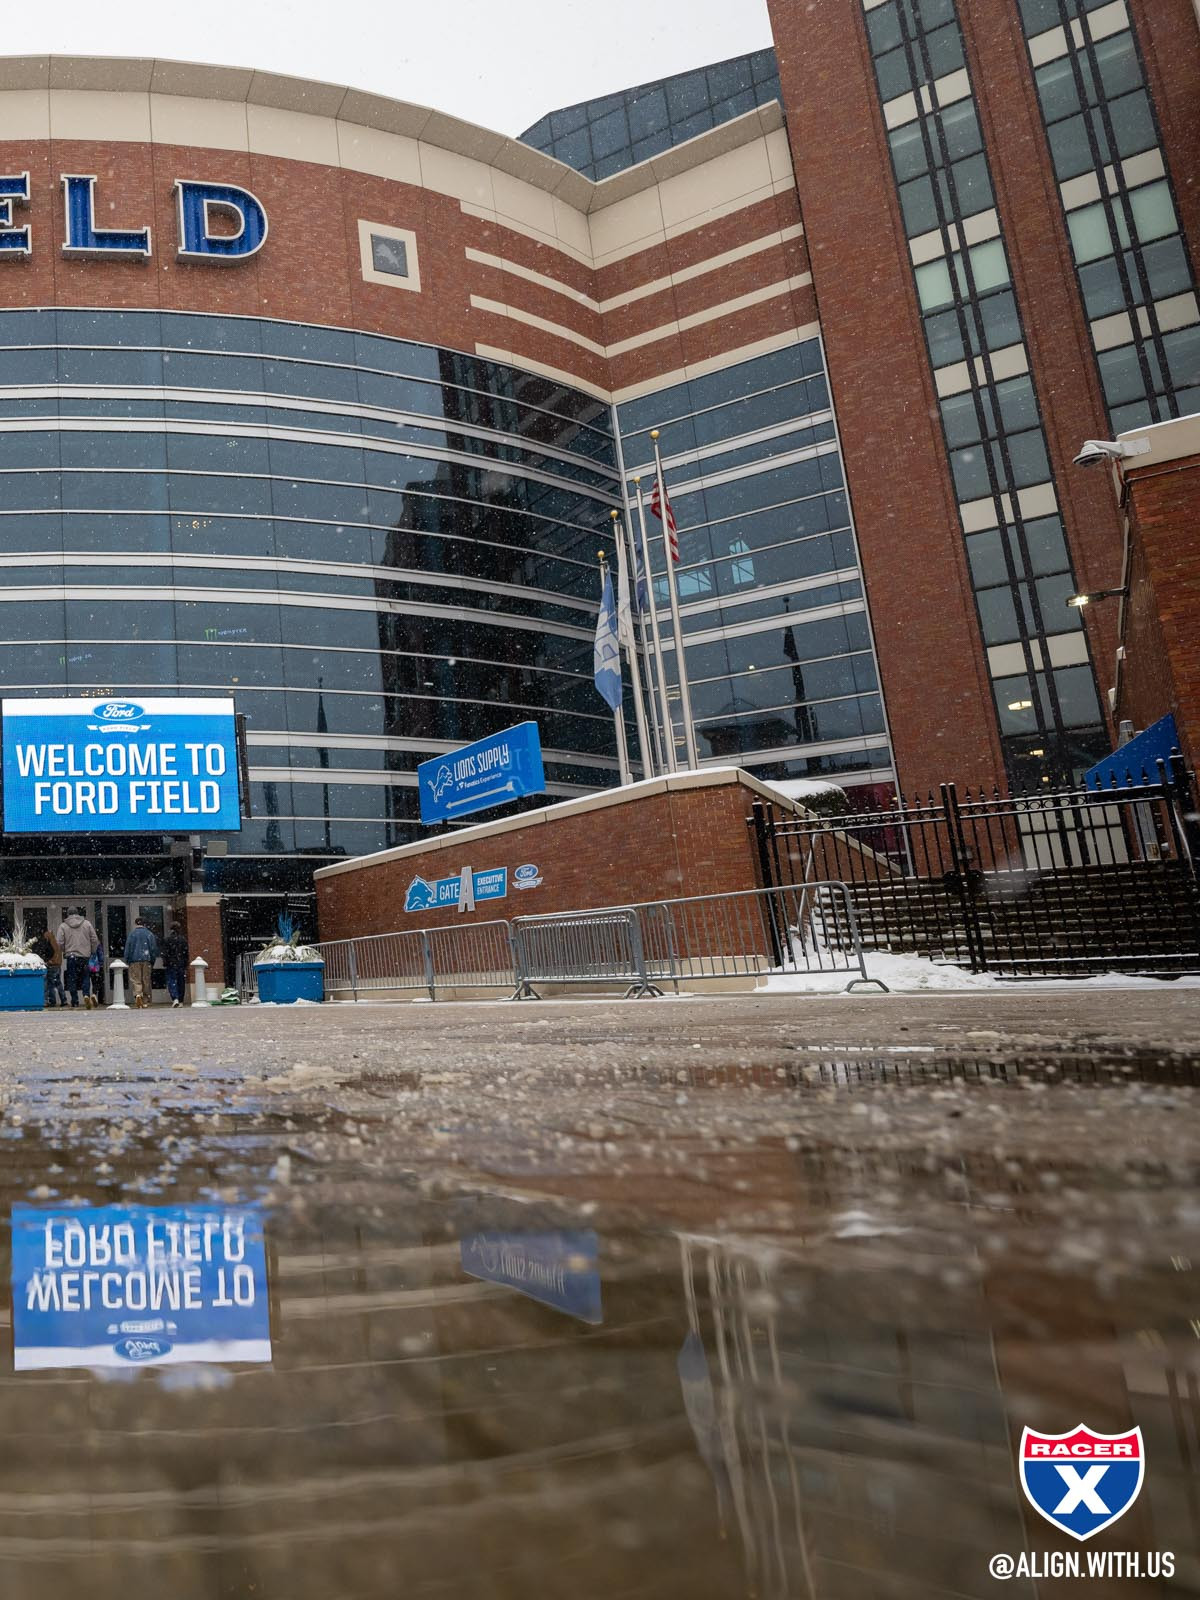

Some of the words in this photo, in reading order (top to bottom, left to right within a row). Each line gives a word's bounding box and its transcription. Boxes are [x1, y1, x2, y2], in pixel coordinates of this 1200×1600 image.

[103, 703, 135, 717] Ford
[16, 743, 177, 777] WELCOME
[185, 743, 226, 776] TO
[453, 756, 476, 781] LIONS
[477, 743, 510, 773] SUPPLY
[34, 780, 119, 815] FORD
[129, 780, 221, 814] FIELD
[439, 882, 460, 901] GATE
[458, 866, 475, 912] A
[477, 873, 503, 884] EXECUTIVE
[477, 884, 500, 895] ENTRANCE
